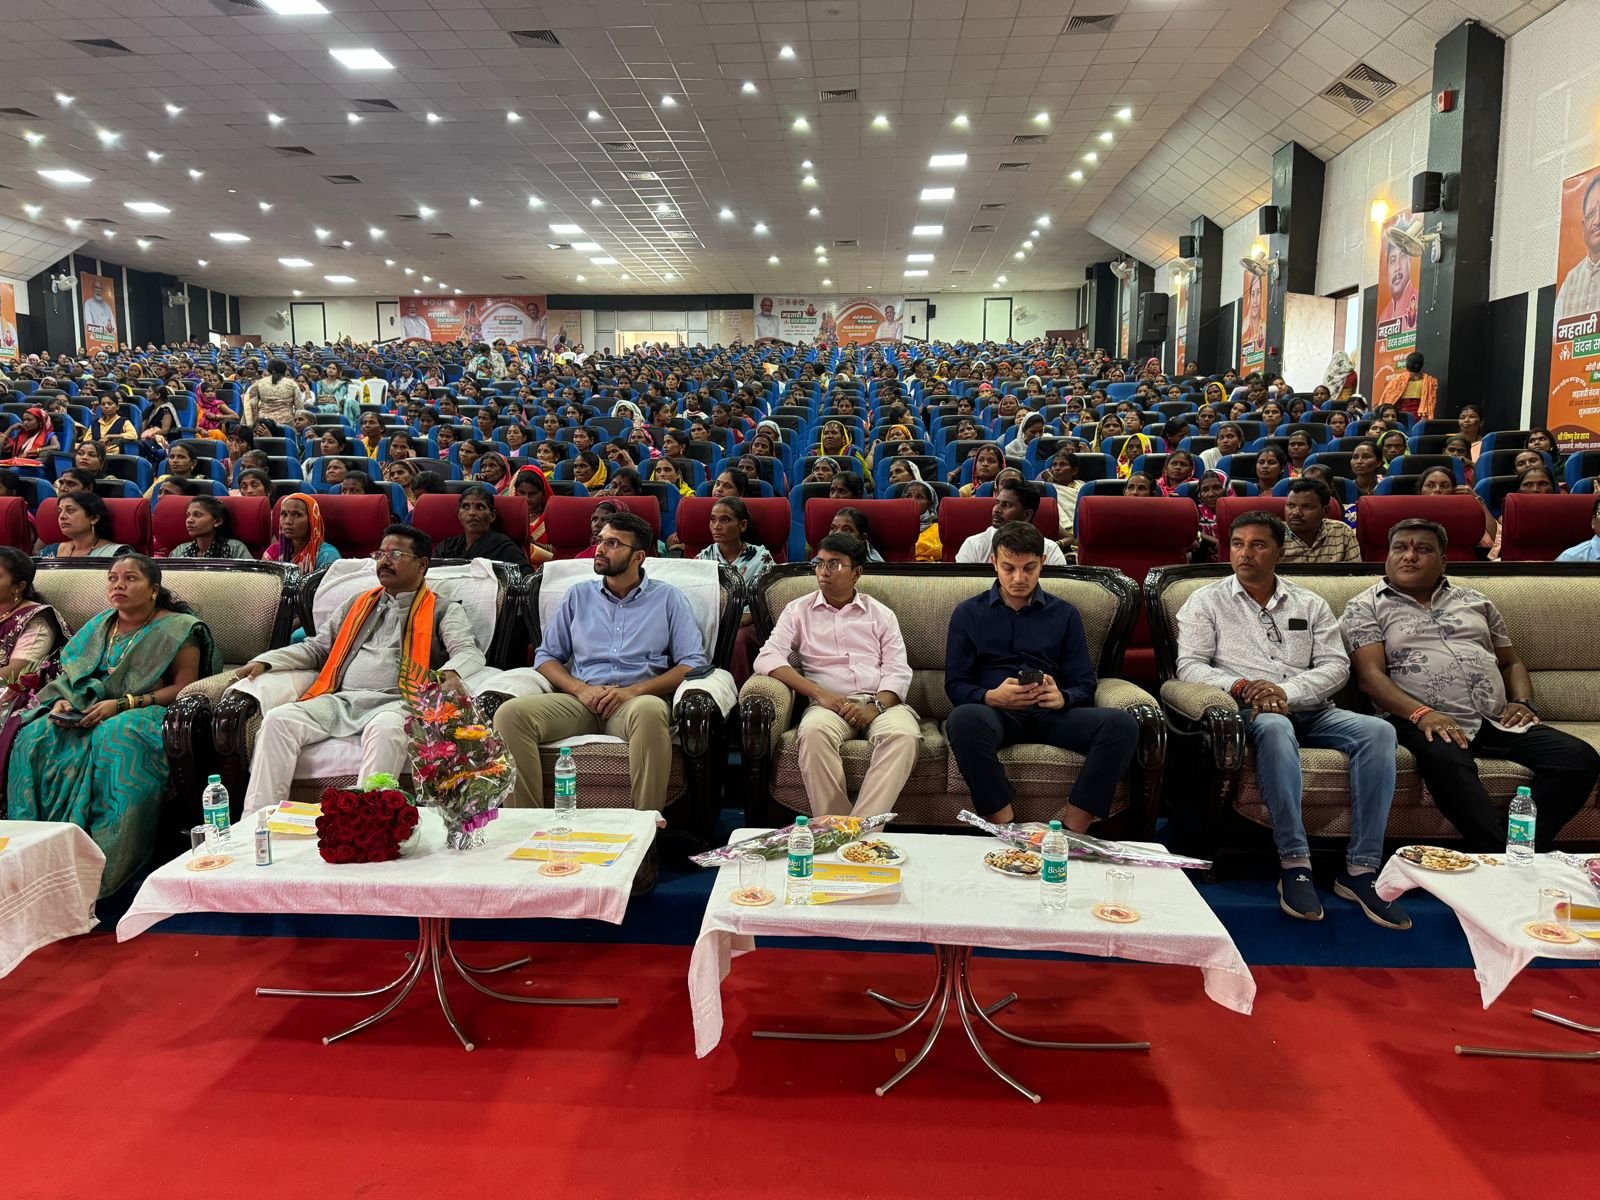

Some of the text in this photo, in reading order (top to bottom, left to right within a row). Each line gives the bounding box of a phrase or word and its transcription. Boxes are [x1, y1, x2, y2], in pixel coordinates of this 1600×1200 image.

[1378, 319, 1401, 337] महतारी
[1558, 313, 1597, 339] महतारी
[1574, 338, 1592, 353] वंदन
